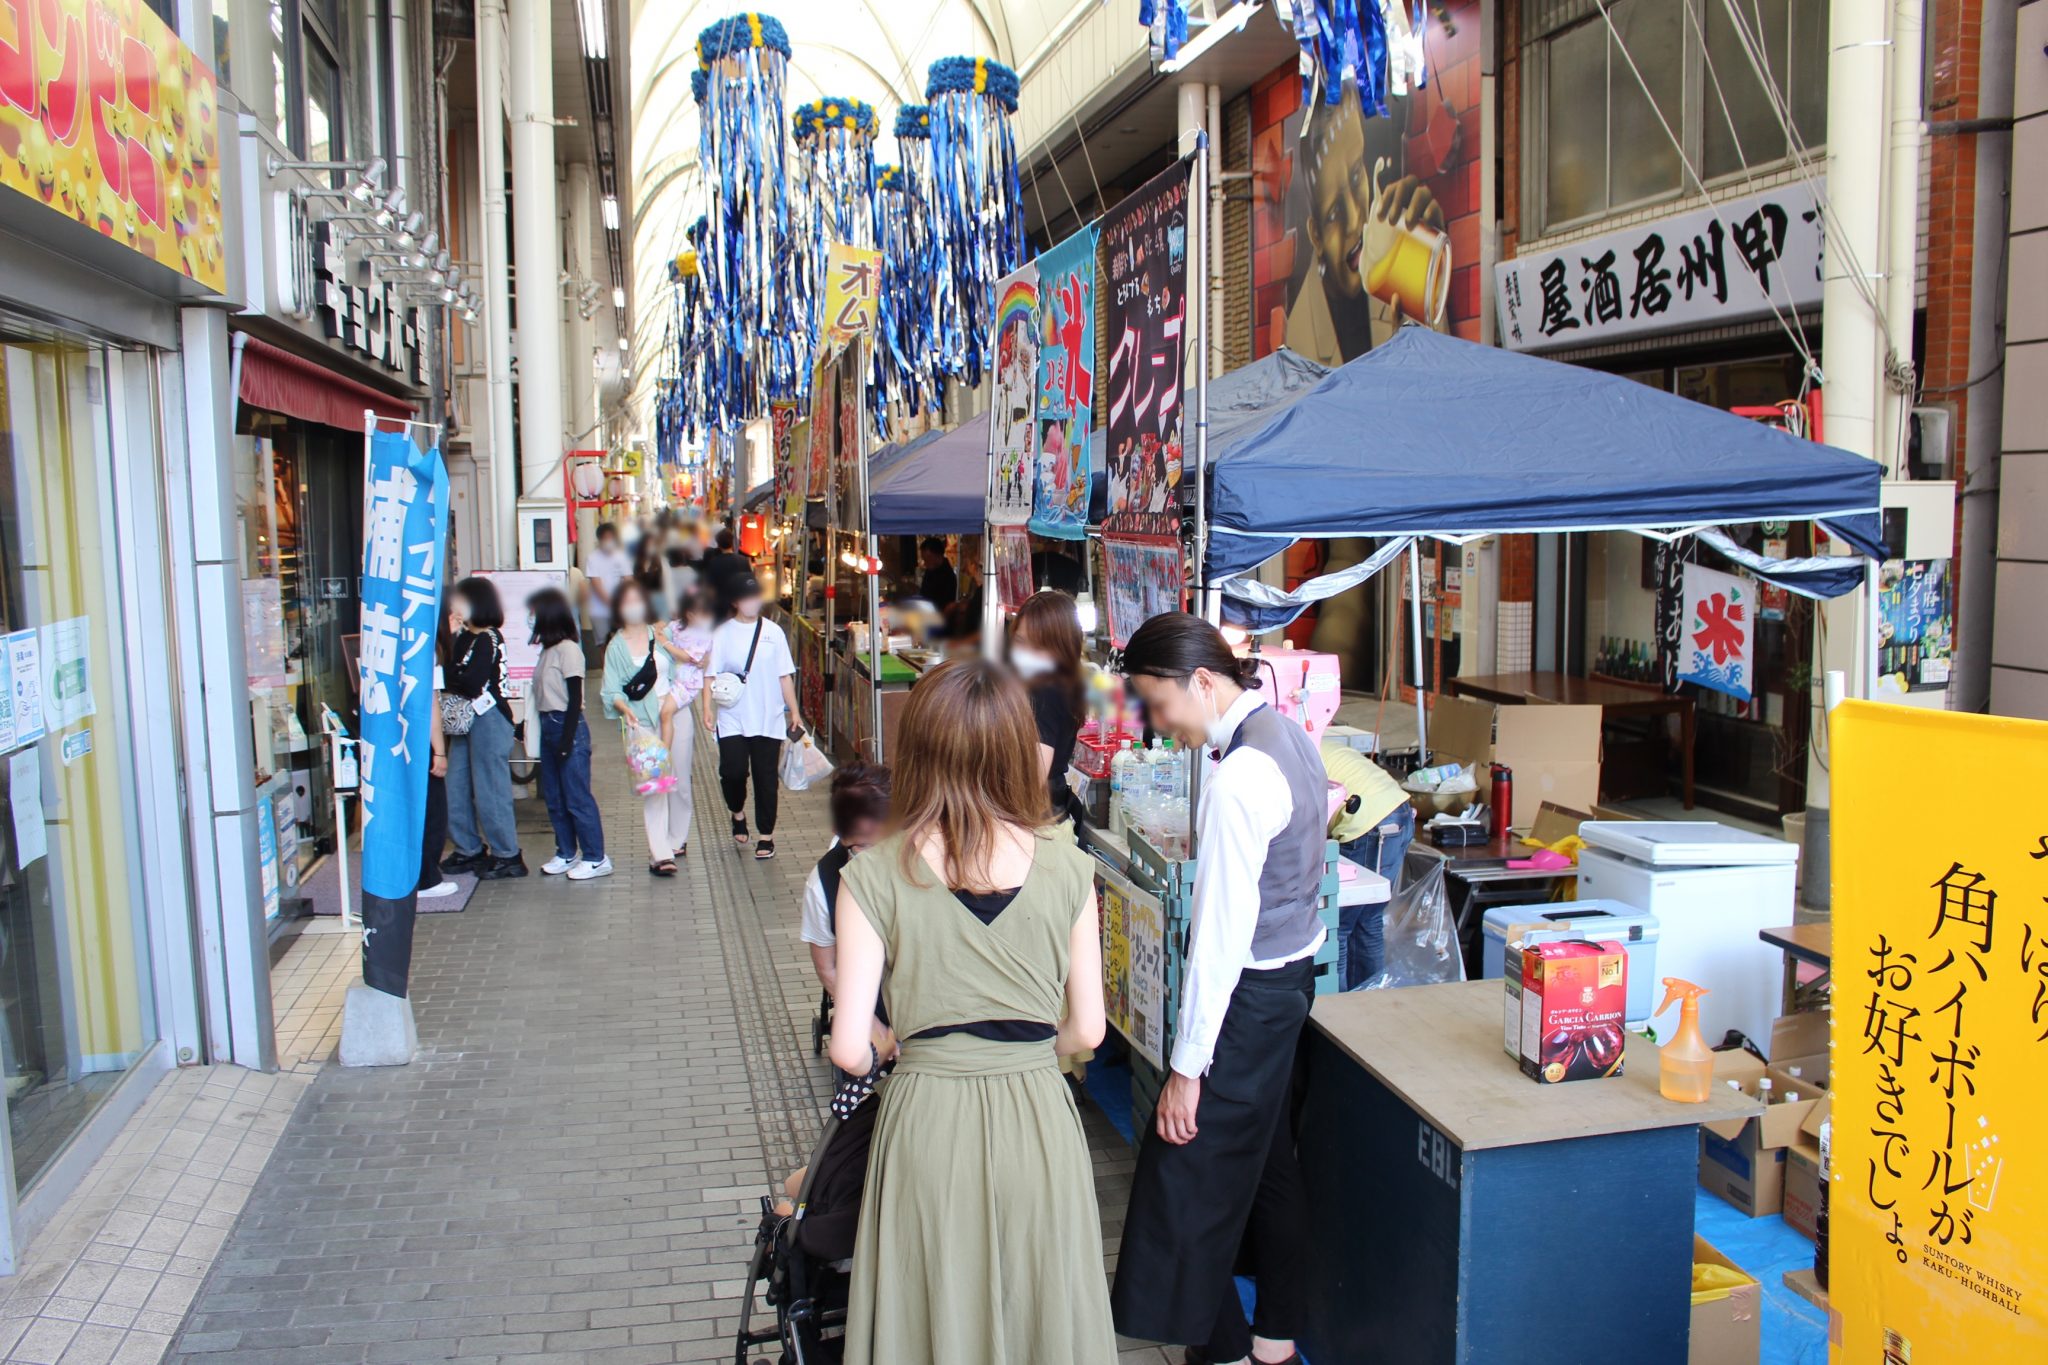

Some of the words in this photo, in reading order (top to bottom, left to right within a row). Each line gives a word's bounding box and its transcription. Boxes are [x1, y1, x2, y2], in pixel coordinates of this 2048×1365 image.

[1109, 294, 1185, 428] クレープ
[1862, 933, 1921, 1264] お好きでしょ。
[1921, 862, 1999, 1246] 角ハイボールが
[1923, 1244, 1973, 1277] SUNTORY
[1976, 1270, 2023, 1302] WHISKY
